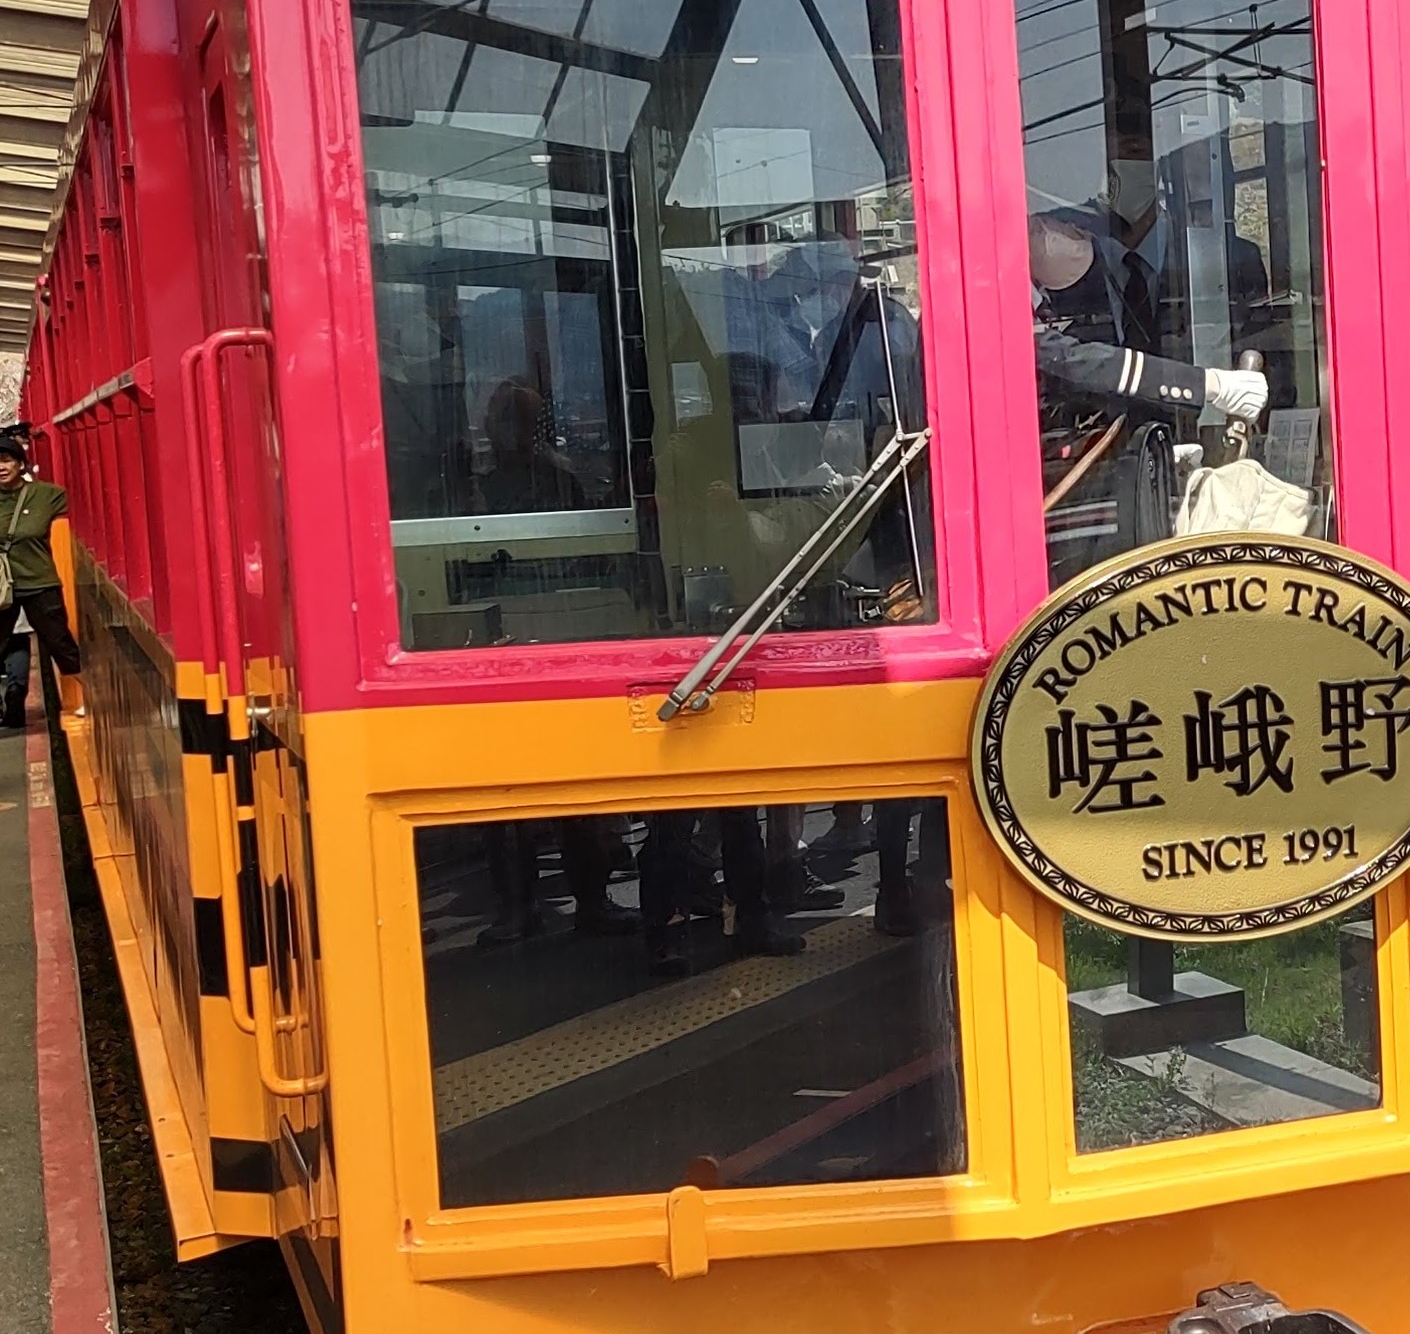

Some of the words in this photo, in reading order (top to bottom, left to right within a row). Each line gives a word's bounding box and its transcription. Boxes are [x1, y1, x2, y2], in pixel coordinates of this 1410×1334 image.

[1032, 576, 1269, 705] ROMANTIC
[1141, 833, 1269, 881] SINCE
[1283, 824, 1359, 864] 1991
